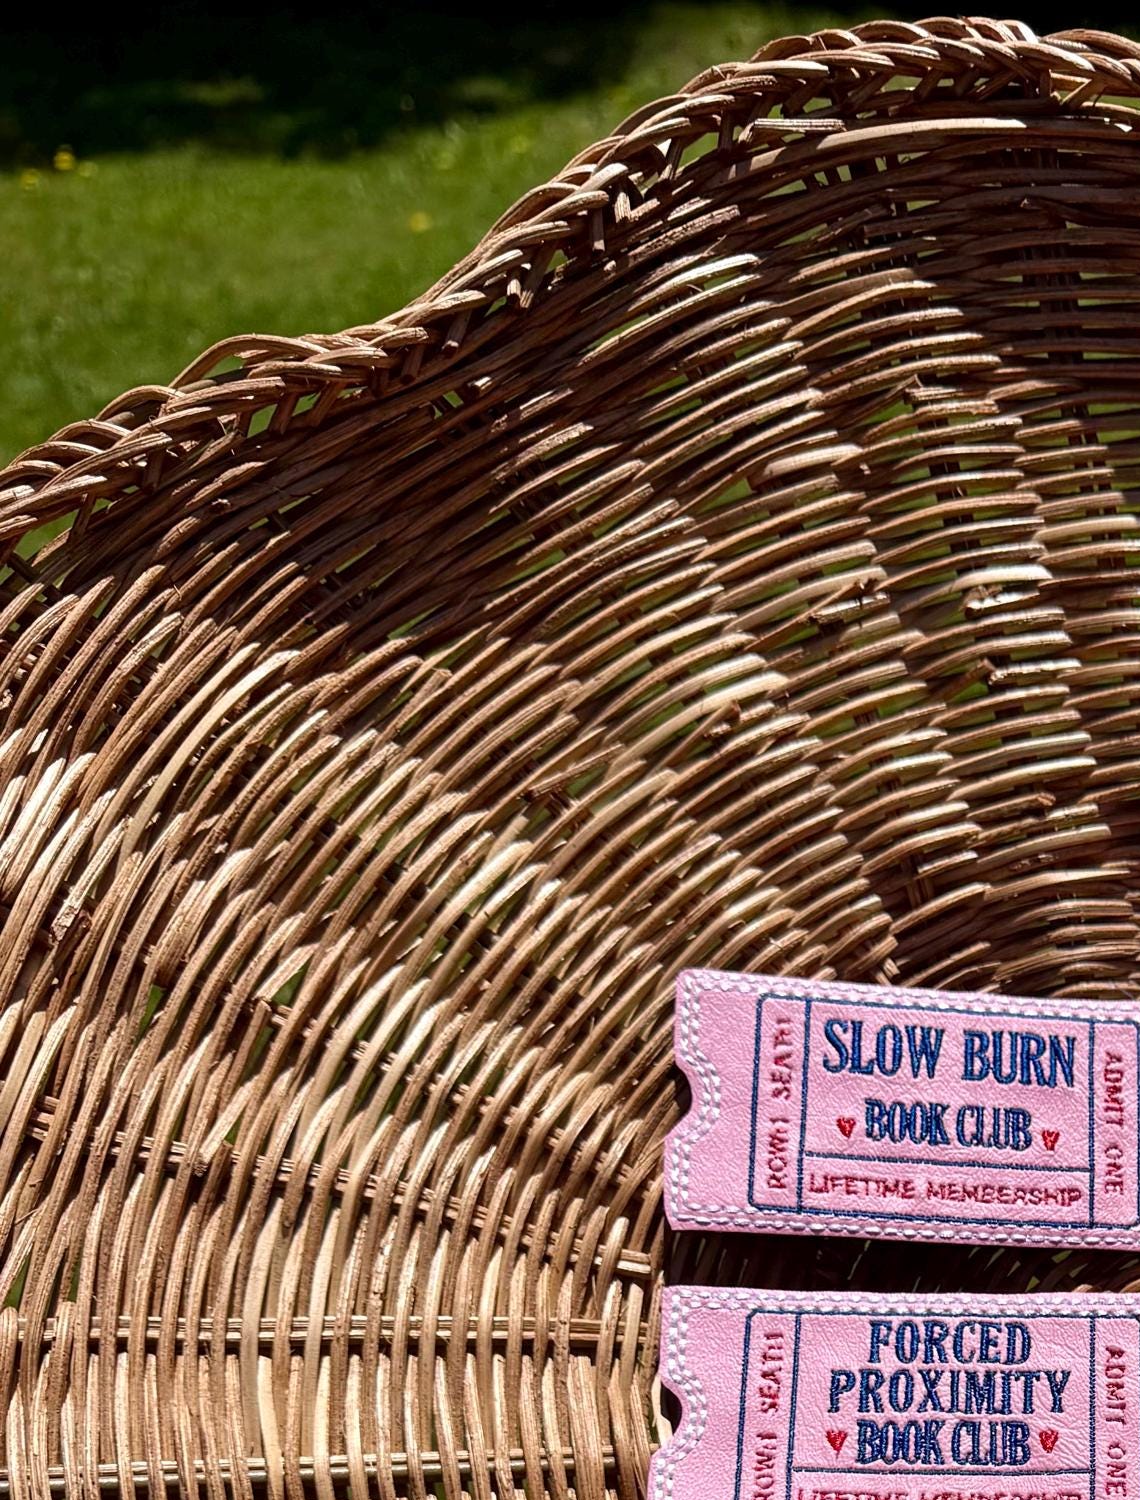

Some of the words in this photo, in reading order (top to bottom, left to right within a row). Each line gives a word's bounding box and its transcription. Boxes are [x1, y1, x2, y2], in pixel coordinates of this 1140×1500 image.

[822, 1018, 945, 1079] SLOW
[961, 1029, 1075, 1089] BURN
[1104, 1050, 1125, 1130] ADMIT
[865, 1099, 951, 1146] BOOK
[956, 1104, 1033, 1152] CLUB
[808, 1173, 915, 1200] LIFETIME
[926, 1179, 1082, 1208] MEMBERSHIP
[1104, 1143, 1125, 1195] ONE
[868, 1319, 1031, 1365] FORCED
[827, 1369, 1071, 1414] PROXIMITY
[1105, 1344, 1126, 1426] ADMIT
[856, 1420, 946, 1465] BOOK
[951, 1421, 1031, 1466] CLUB
[1105, 1442, 1127, 1499] ONE
